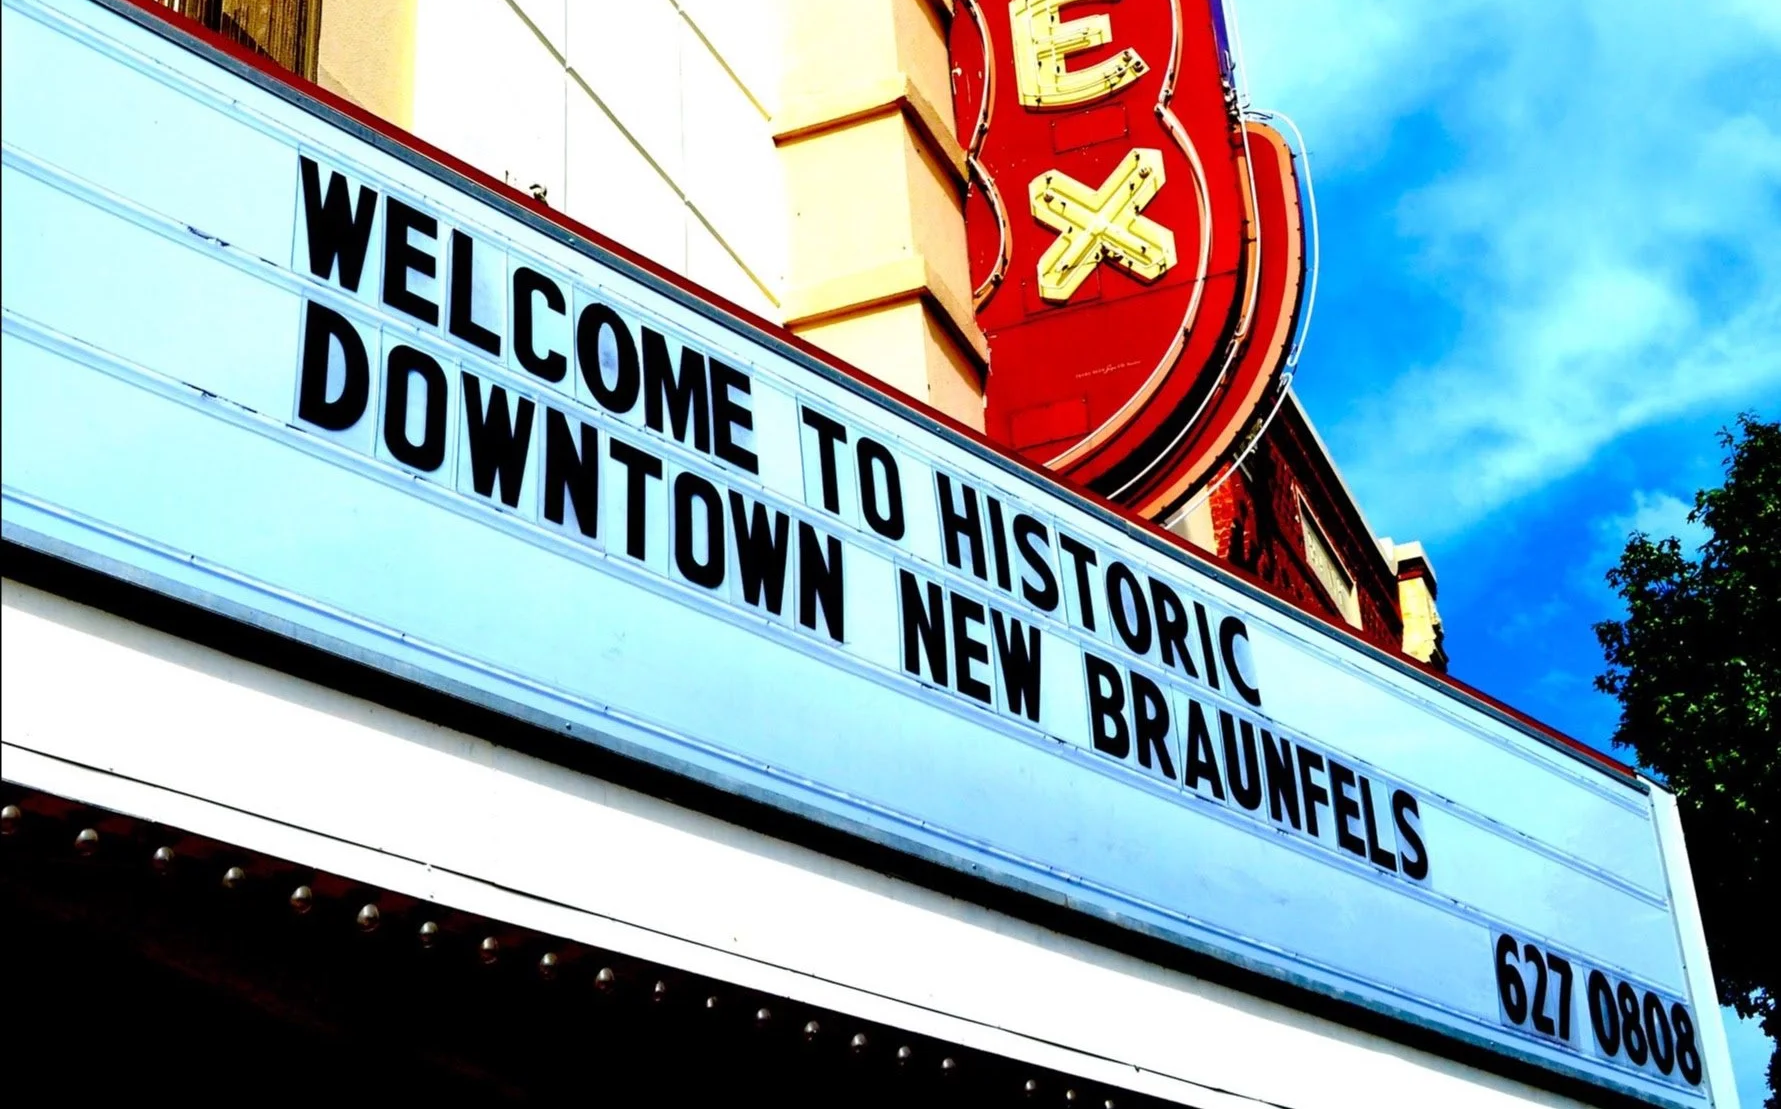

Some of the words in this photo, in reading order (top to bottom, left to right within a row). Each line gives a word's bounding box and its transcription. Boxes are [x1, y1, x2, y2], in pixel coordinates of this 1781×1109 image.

[299, 299, 845, 644] DOWNTOWN
[900, 568, 1042, 724] NEW
[1085, 652, 1429, 881] BRAUNFELS
[300, 155, 759, 475] WELCOME
[802, 405, 905, 541] TO
[936, 471, 1261, 707] HISTORIC
[1496, 933, 1573, 1041] 627
[1588, 969, 1702, 1086] 0808
